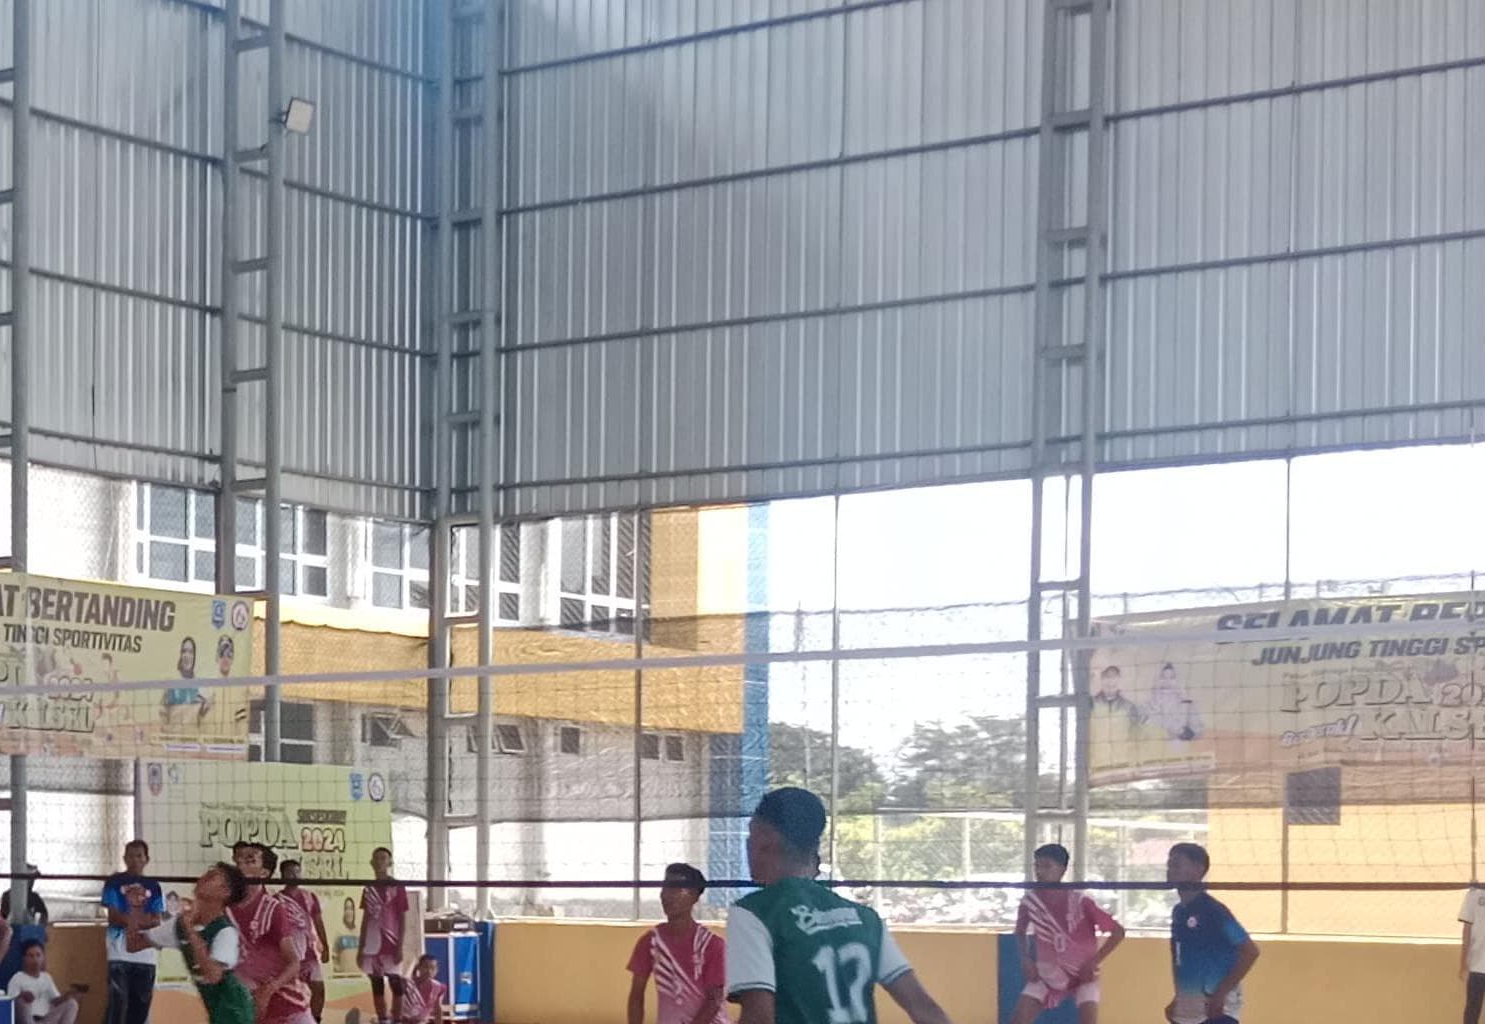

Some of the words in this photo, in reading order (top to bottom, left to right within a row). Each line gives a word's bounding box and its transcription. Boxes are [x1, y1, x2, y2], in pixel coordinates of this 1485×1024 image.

[26, 586, 176, 632] BERTANDING
[53, 628, 143, 652] SPORTIVITAS
[1252, 640, 1361, 666] JUNJUNG
[1369, 637, 1448, 658] TINGGI
[301, 827, 346, 853] 2024
